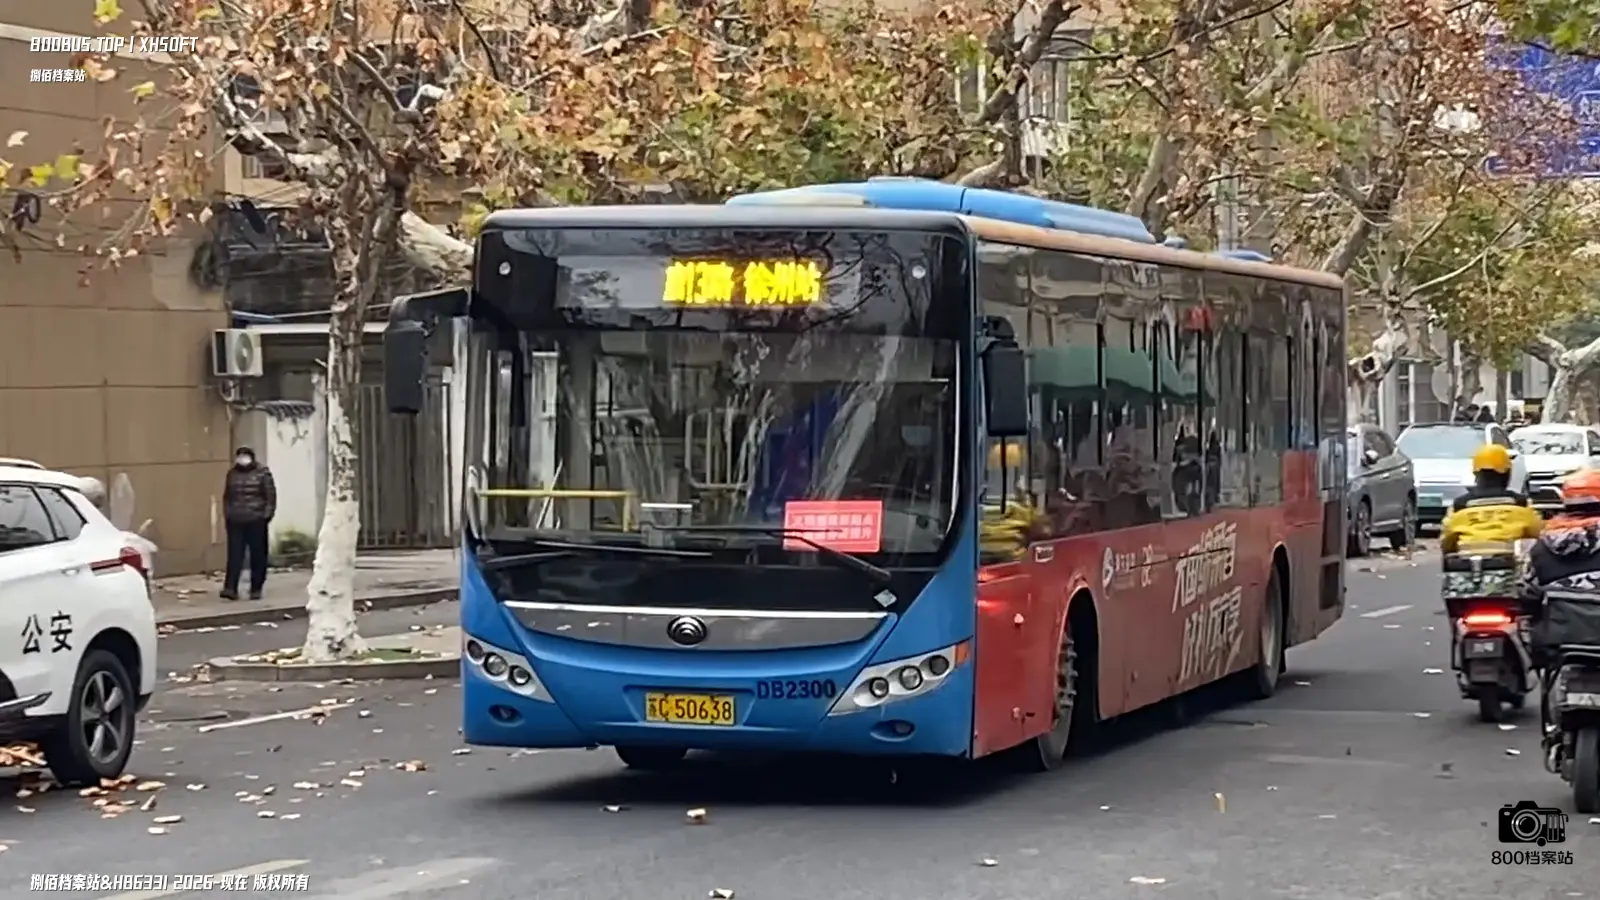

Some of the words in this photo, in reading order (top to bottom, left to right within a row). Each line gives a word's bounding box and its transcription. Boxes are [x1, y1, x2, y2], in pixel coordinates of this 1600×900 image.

[743, 260, 822, 304] 徐州站
[21, 609, 73, 655] 公安
[756, 679, 836, 700] DB2300
